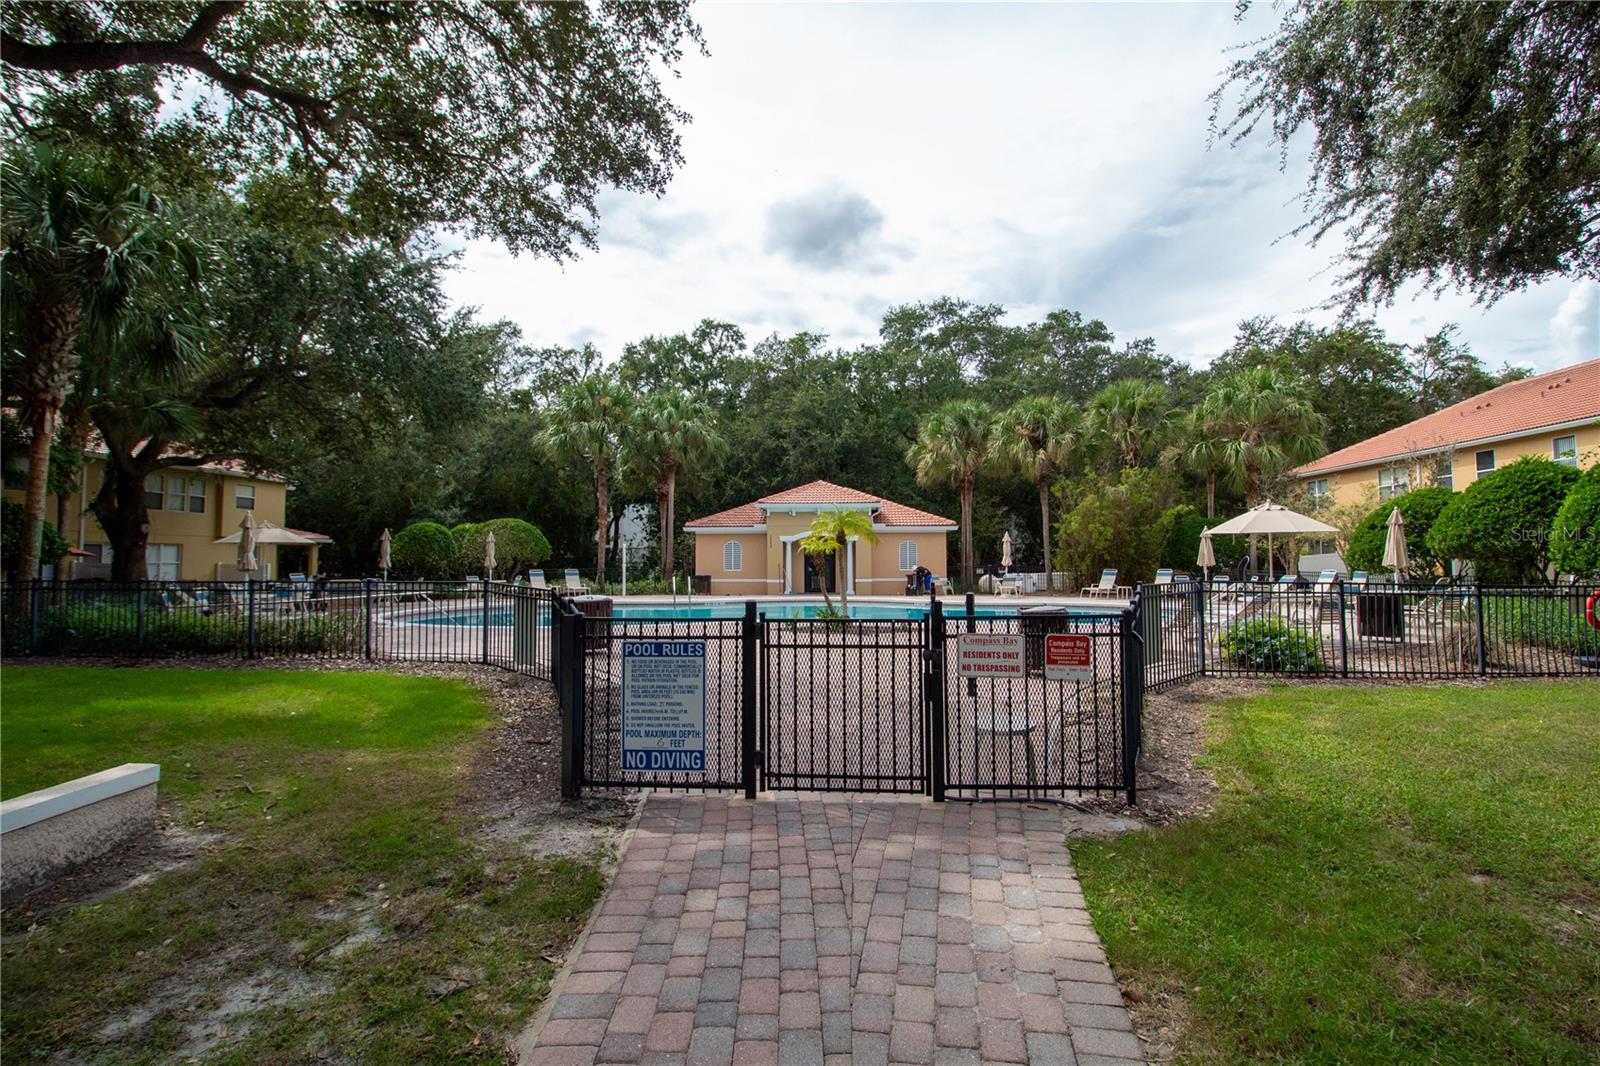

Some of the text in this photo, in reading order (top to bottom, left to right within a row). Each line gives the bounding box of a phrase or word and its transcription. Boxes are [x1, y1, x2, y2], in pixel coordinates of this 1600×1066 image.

[963, 637, 1018, 646] Compass Bay
[625, 644, 703, 656] POOL RULES
[963, 651, 1019, 659] RESIDENTS ONLY
[974, 664, 1020, 672] TRESPASSING
[626, 730, 702, 738] POOL MAXIMUM DEPTH:
[670, 739, 685, 747] FEET
[626, 752, 701, 768] NO DIVING
